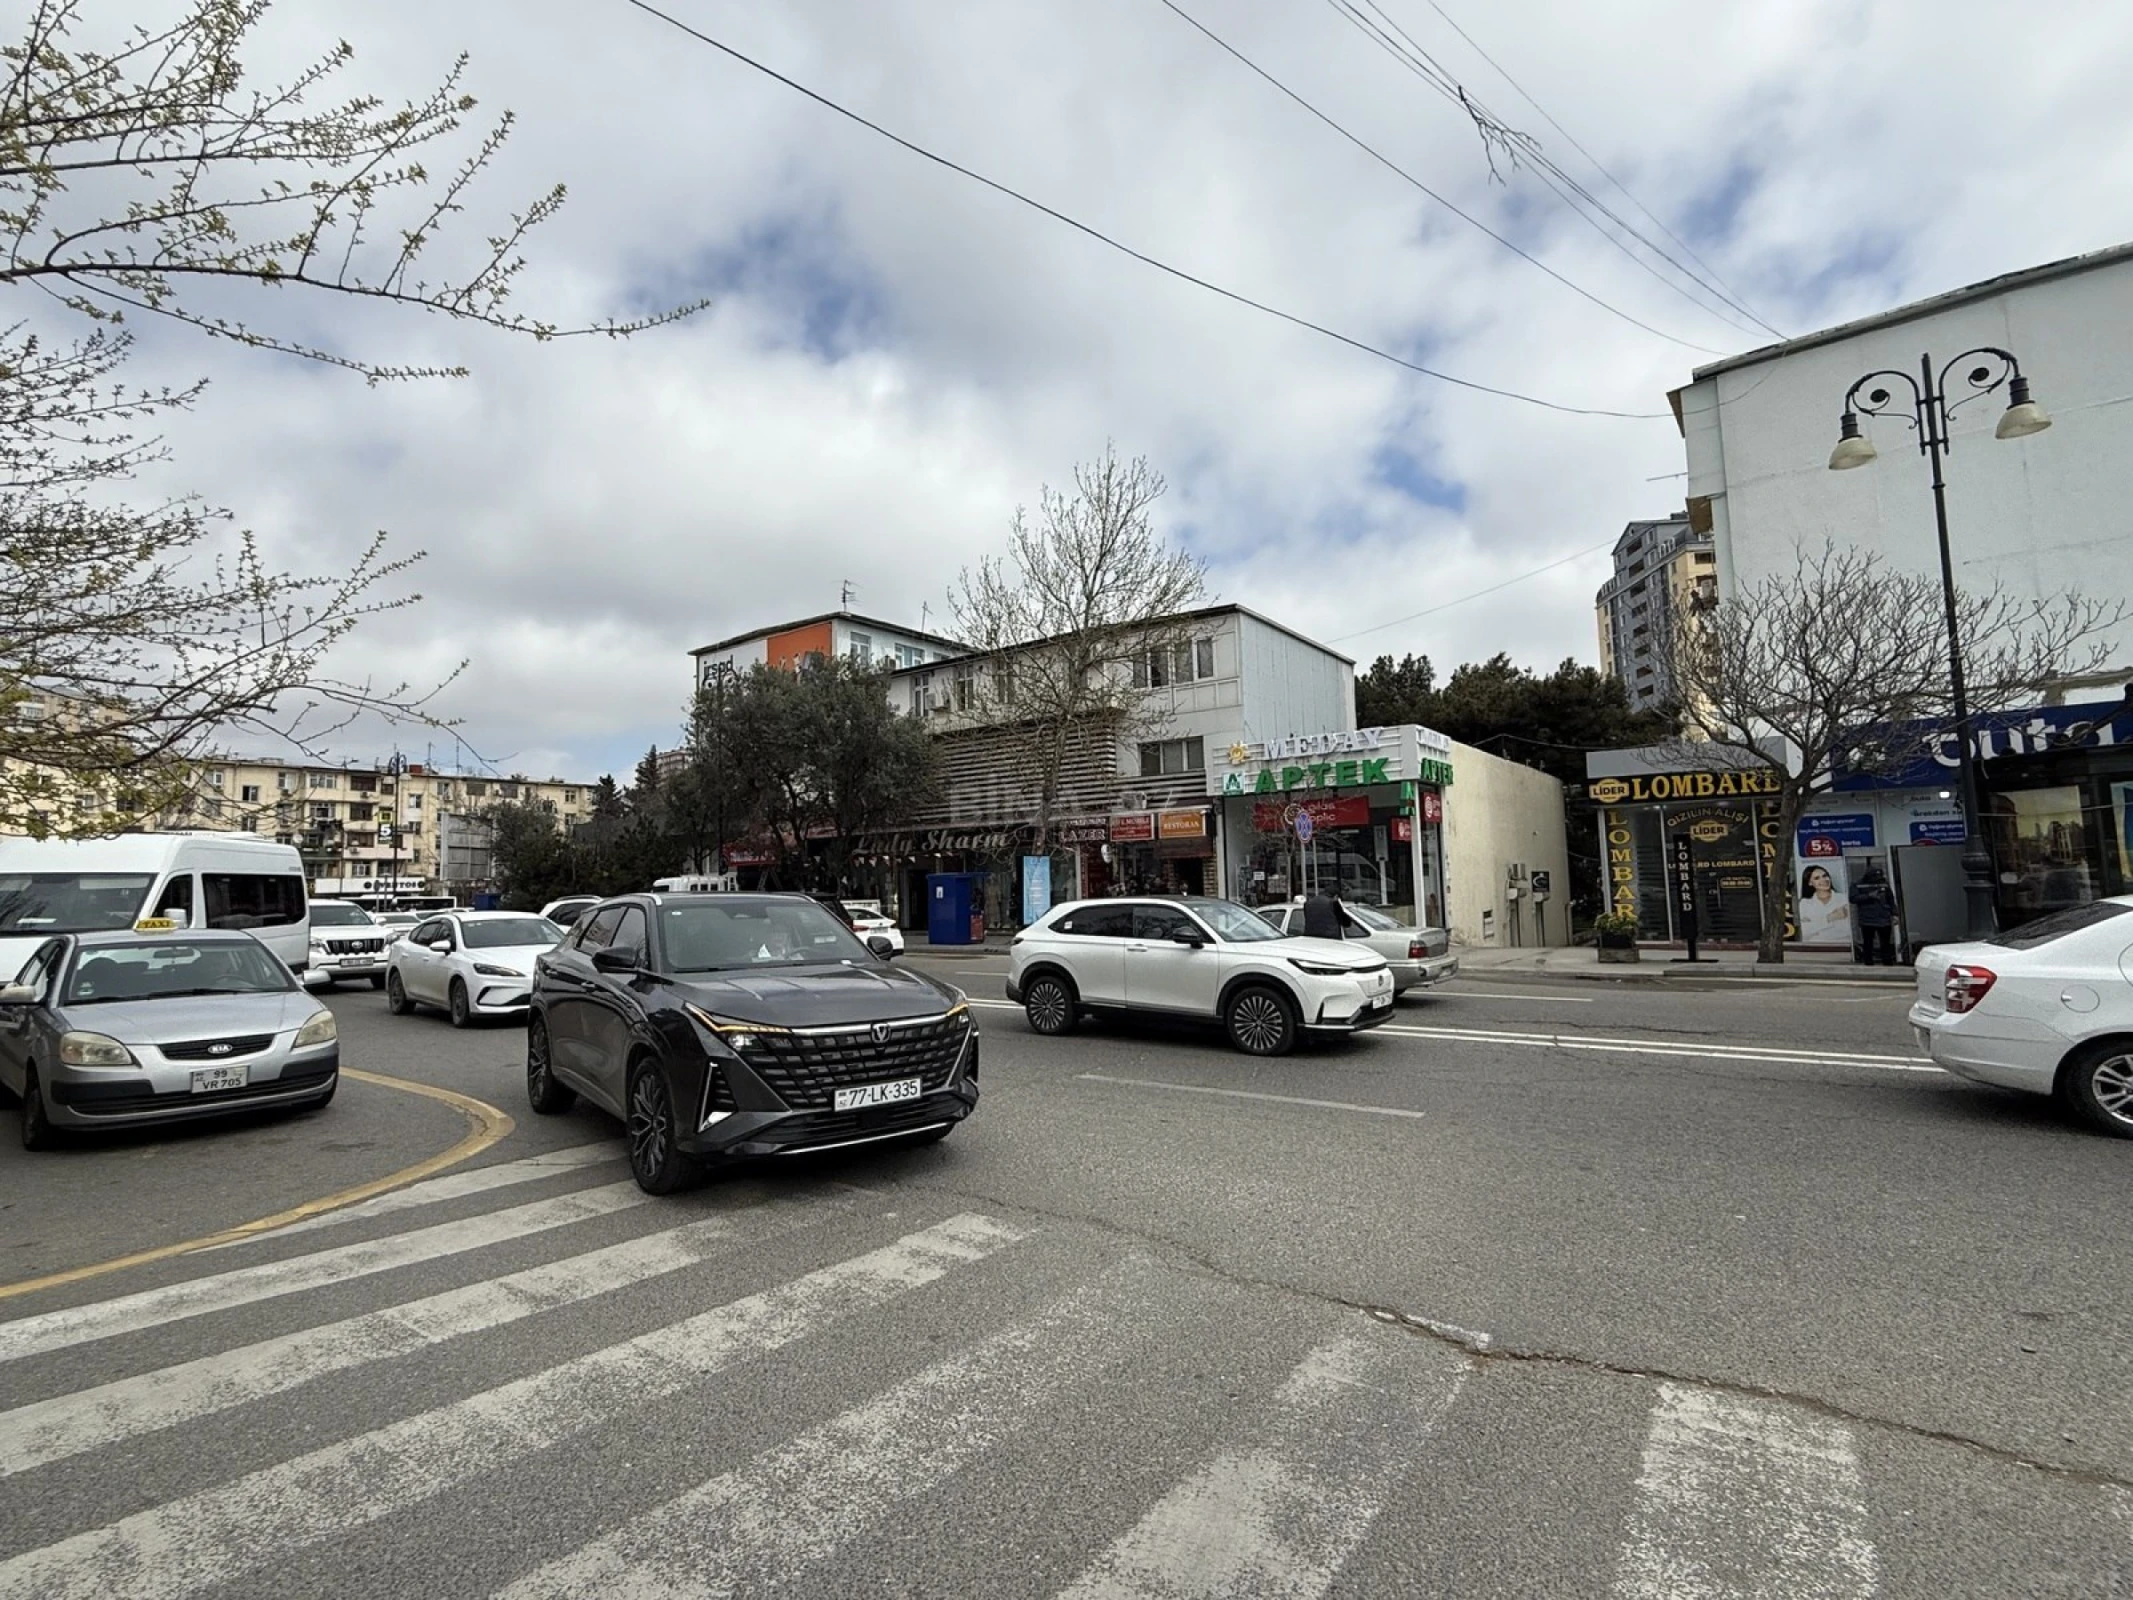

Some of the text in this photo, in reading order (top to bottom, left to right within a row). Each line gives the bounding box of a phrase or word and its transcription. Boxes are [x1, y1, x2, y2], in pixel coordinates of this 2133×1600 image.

[1256, 757, 1389, 792] APTEK
[1811, 840, 1832, 852] 5%
[1608, 811, 1637, 921] LOMBAR
[1678, 842, 1692, 911] LOMBARD
[202, 1077, 241, 1090] VR 705
[214, 1070, 228, 1078] 99
[848, 1081, 918, 1106] 77-LK-335
